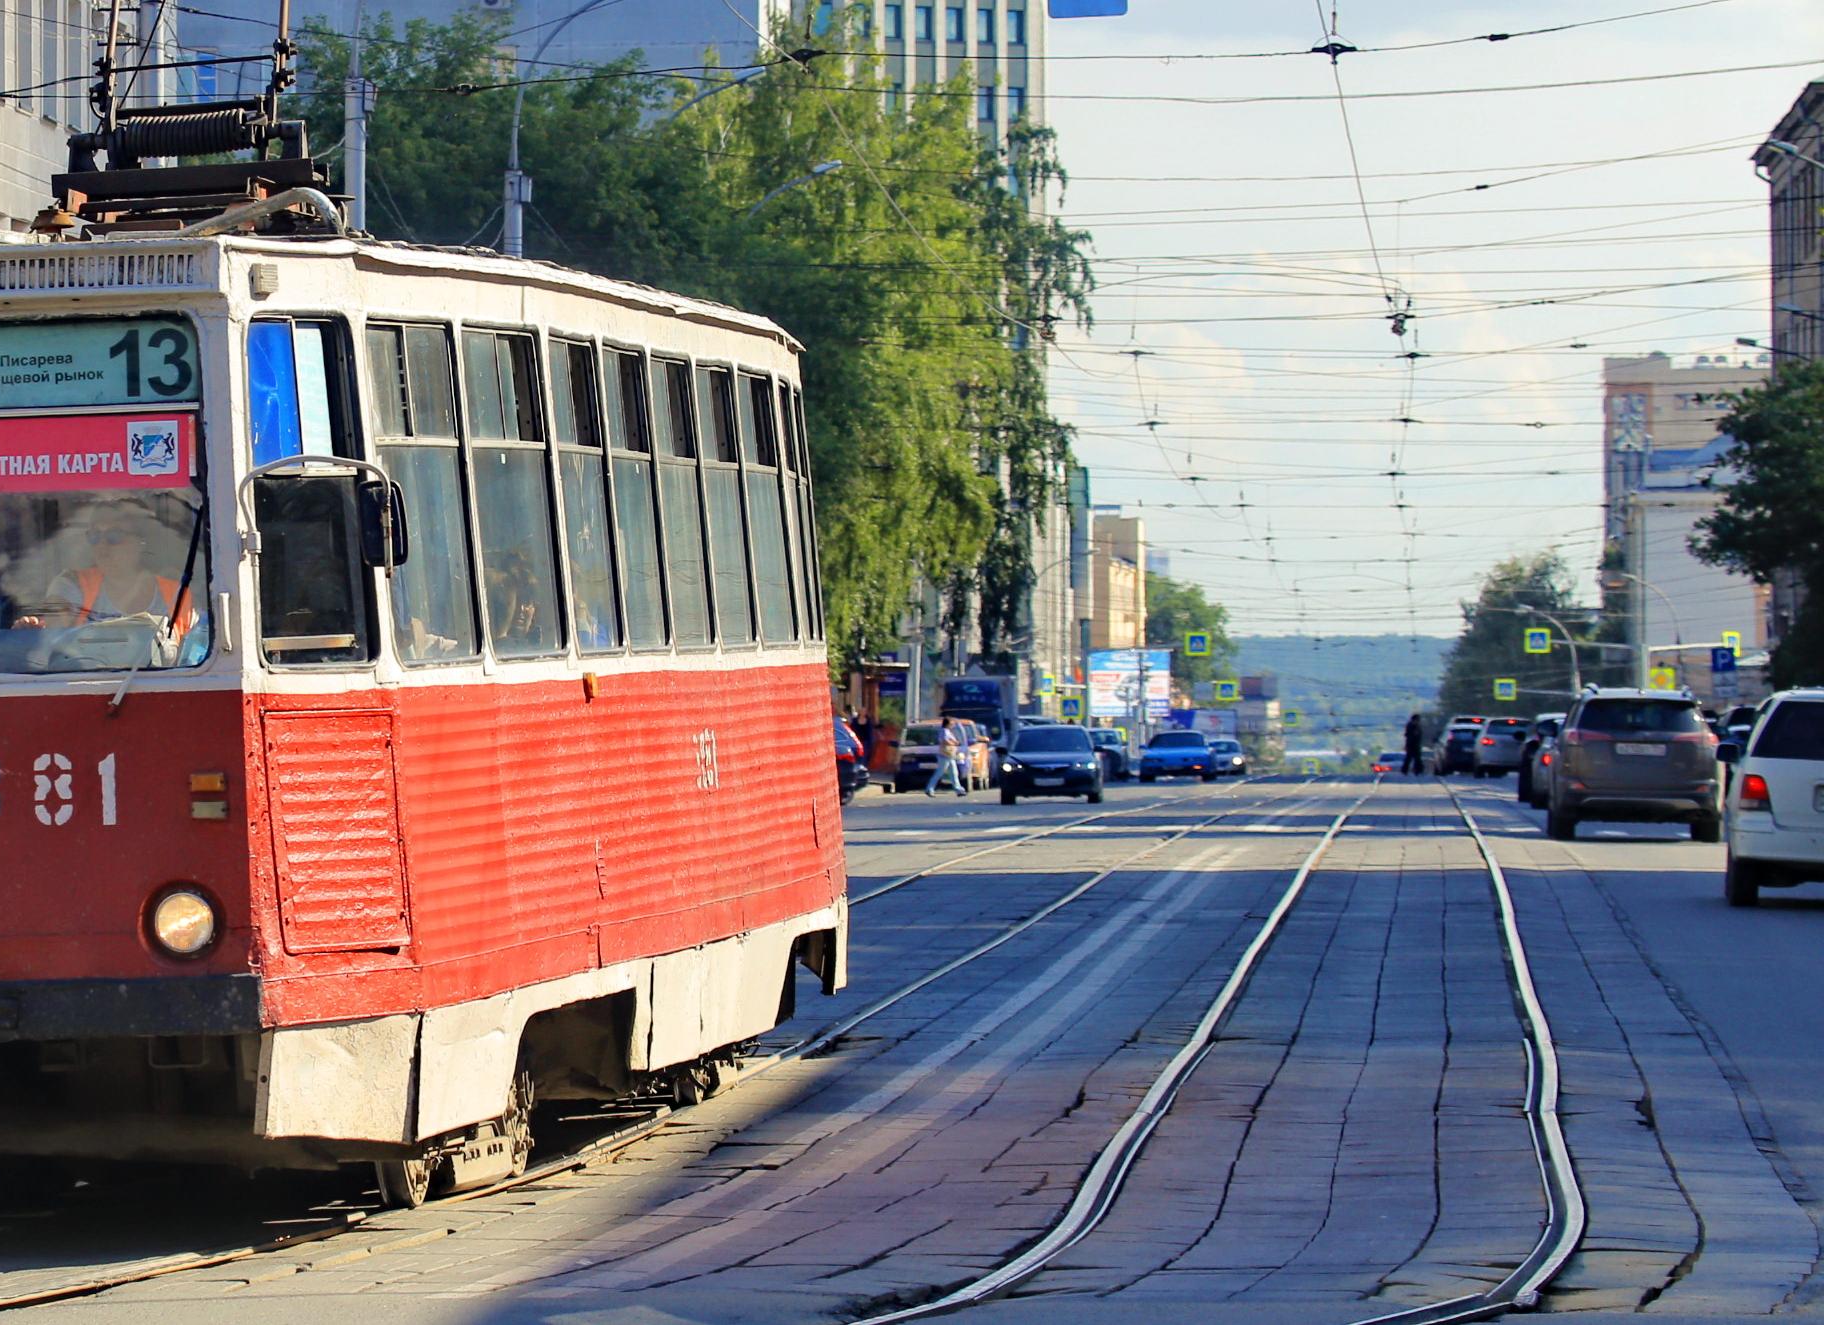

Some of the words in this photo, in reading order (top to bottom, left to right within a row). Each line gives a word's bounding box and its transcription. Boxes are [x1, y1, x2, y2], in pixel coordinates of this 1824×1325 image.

[0, 354, 73, 369] Писарева
[109, 327, 193, 397] 13
[55, 369, 104, 384] рынок
[57, 452, 125, 475] КАРТА
